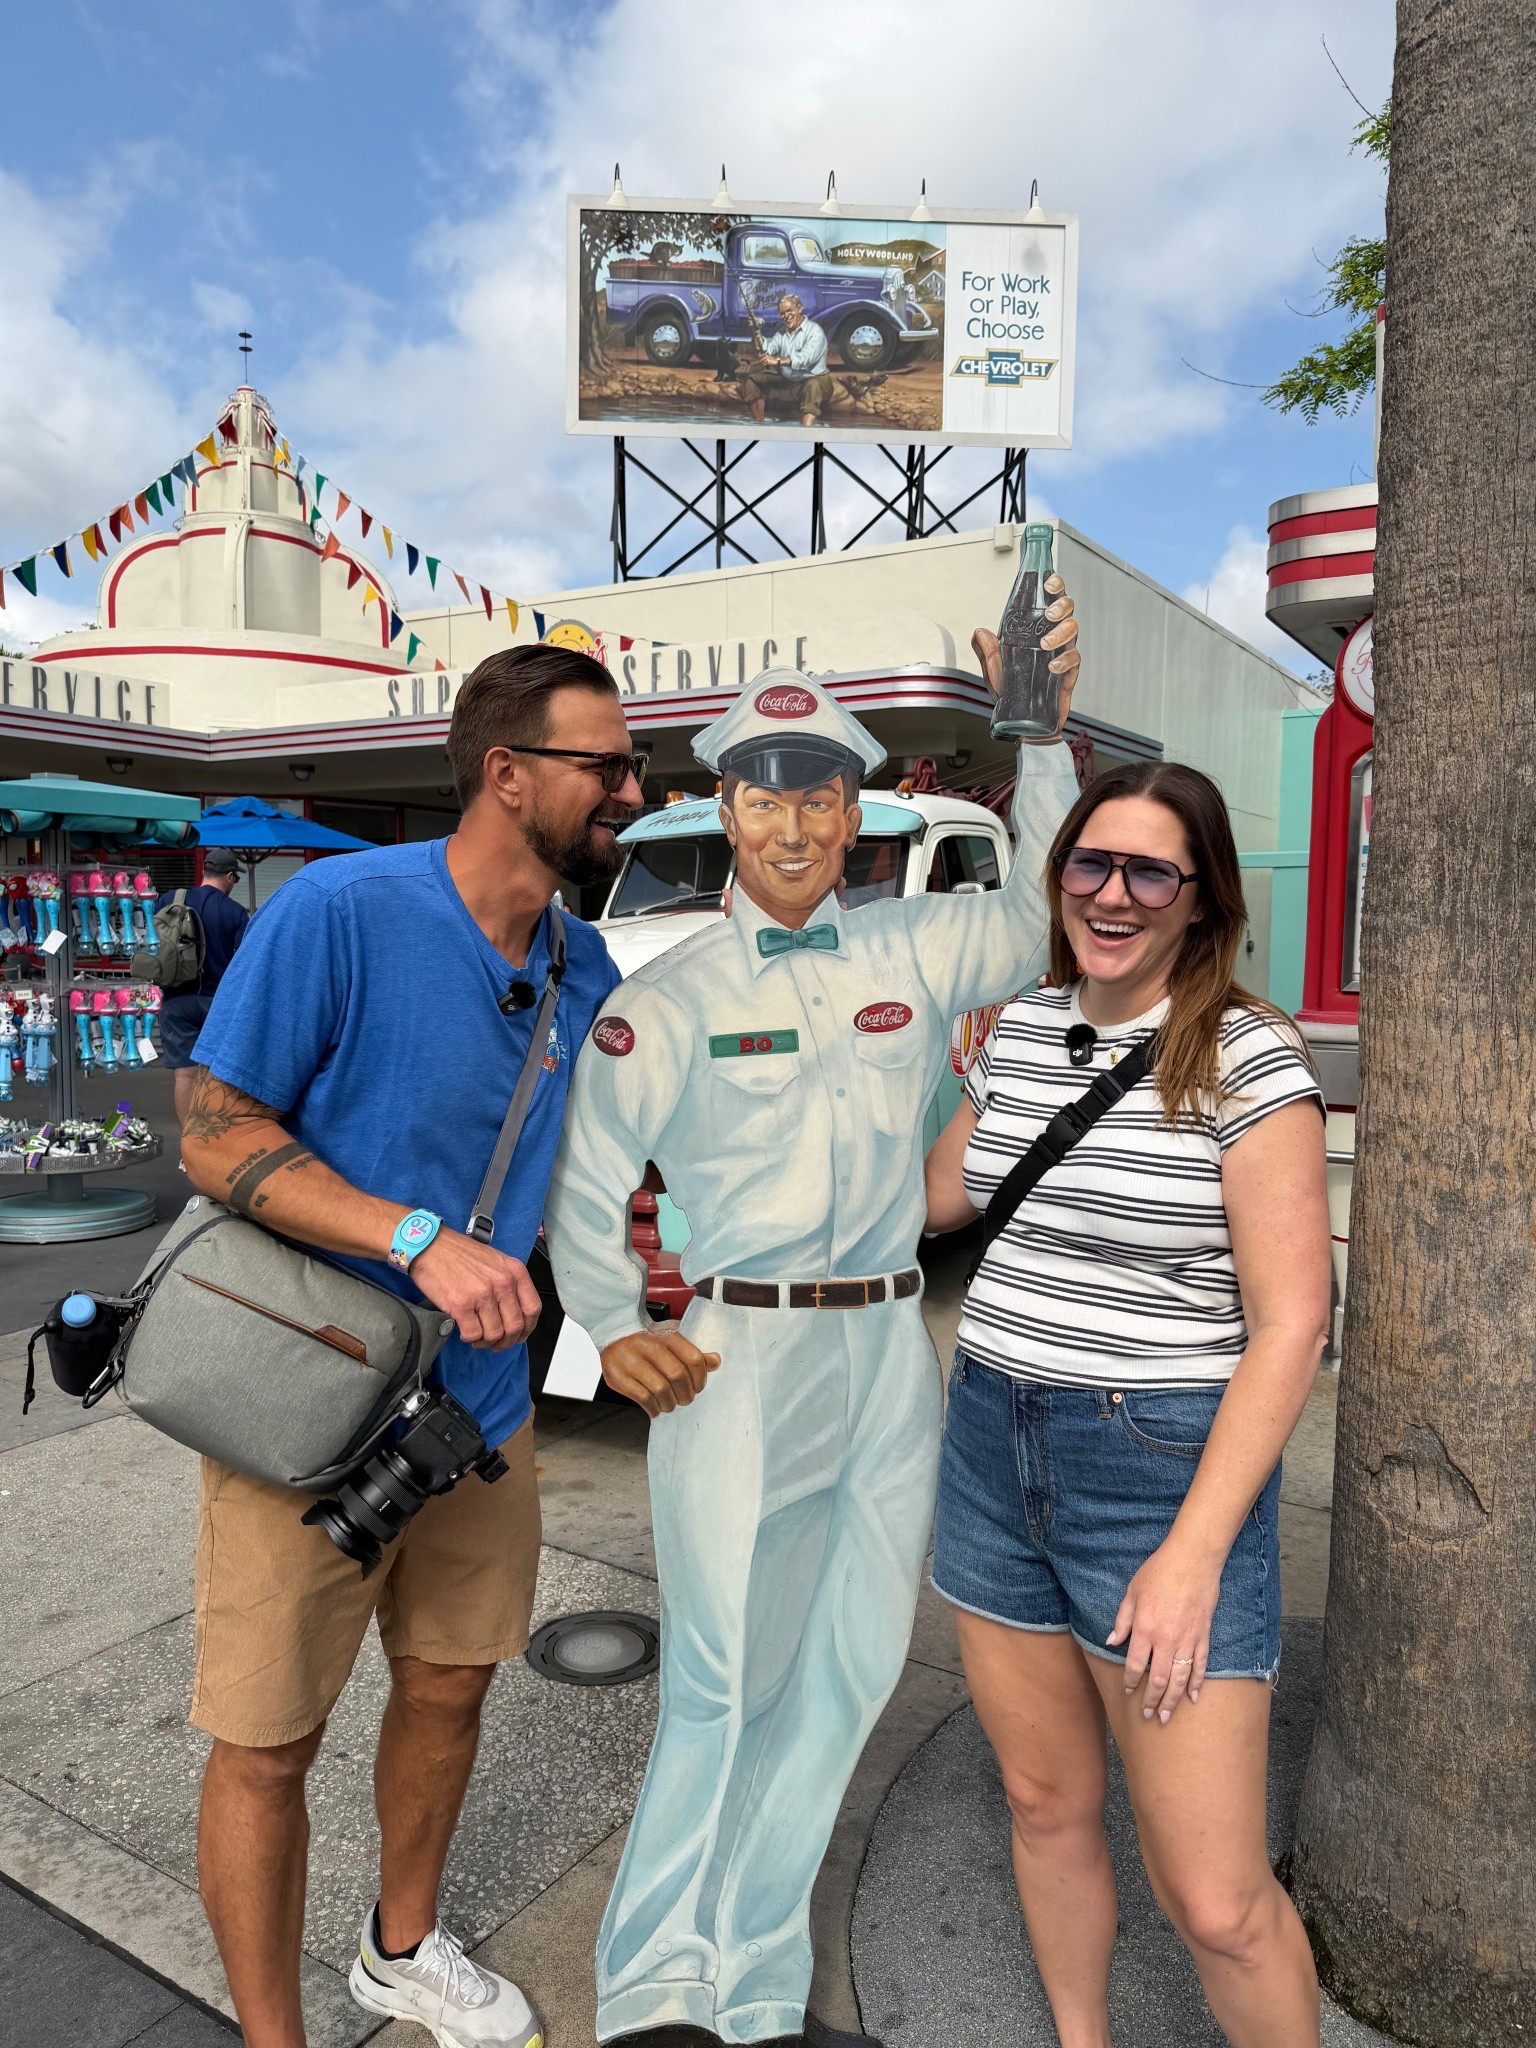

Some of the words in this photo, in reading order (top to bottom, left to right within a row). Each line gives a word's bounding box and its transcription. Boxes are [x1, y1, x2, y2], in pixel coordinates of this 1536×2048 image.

[837, 248, 914, 262] HOLLYWOODLAND
[962, 271, 995, 291] For
[1001, 273, 1051, 294] Work
[970, 298, 994, 314] or
[1001, 295, 1040, 319] Play,
[966, 317, 1045, 341] Choose
[960, 360, 1049, 376] CHEVROLET
[622, 636, 807, 696] SERVICE
[758, 693, 810, 712] Coca-Cola
[858, 1005, 905, 1029] Coca-Cola
[595, 1020, 632, 1050] Coca-Cola
[739, 1035, 773, 1053] BO
